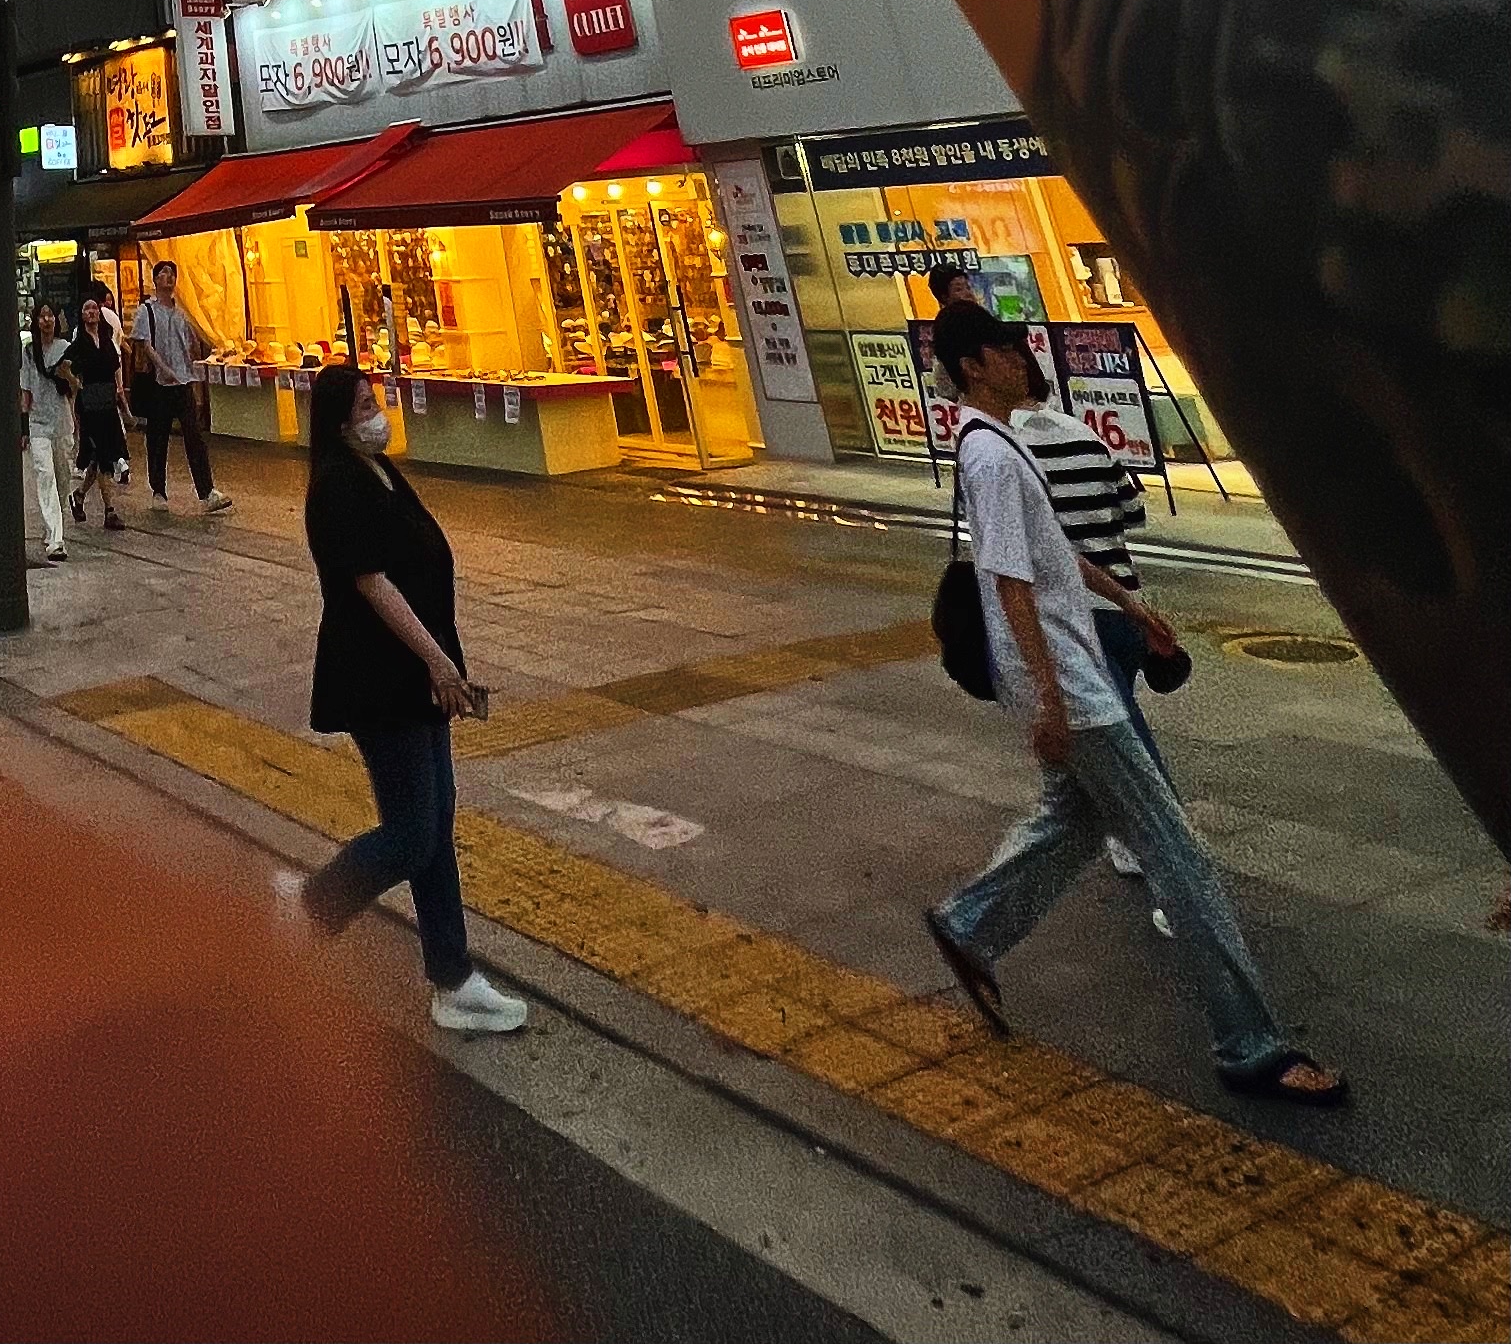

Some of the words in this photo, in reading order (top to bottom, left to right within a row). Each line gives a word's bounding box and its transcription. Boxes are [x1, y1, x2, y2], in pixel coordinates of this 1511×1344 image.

[573, 4, 625, 37] OUTLET
[383, 35, 426, 77] 모자
[259, 60, 290, 96] 모자
[861, 149, 889, 171] 민족
[891, 146, 931, 168] 8천원
[930, 142, 977, 166] 할인을
[976, 139, 996, 161] 내
[864, 364, 915, 390] 고객님
[874, 397, 926, 436] 천원
